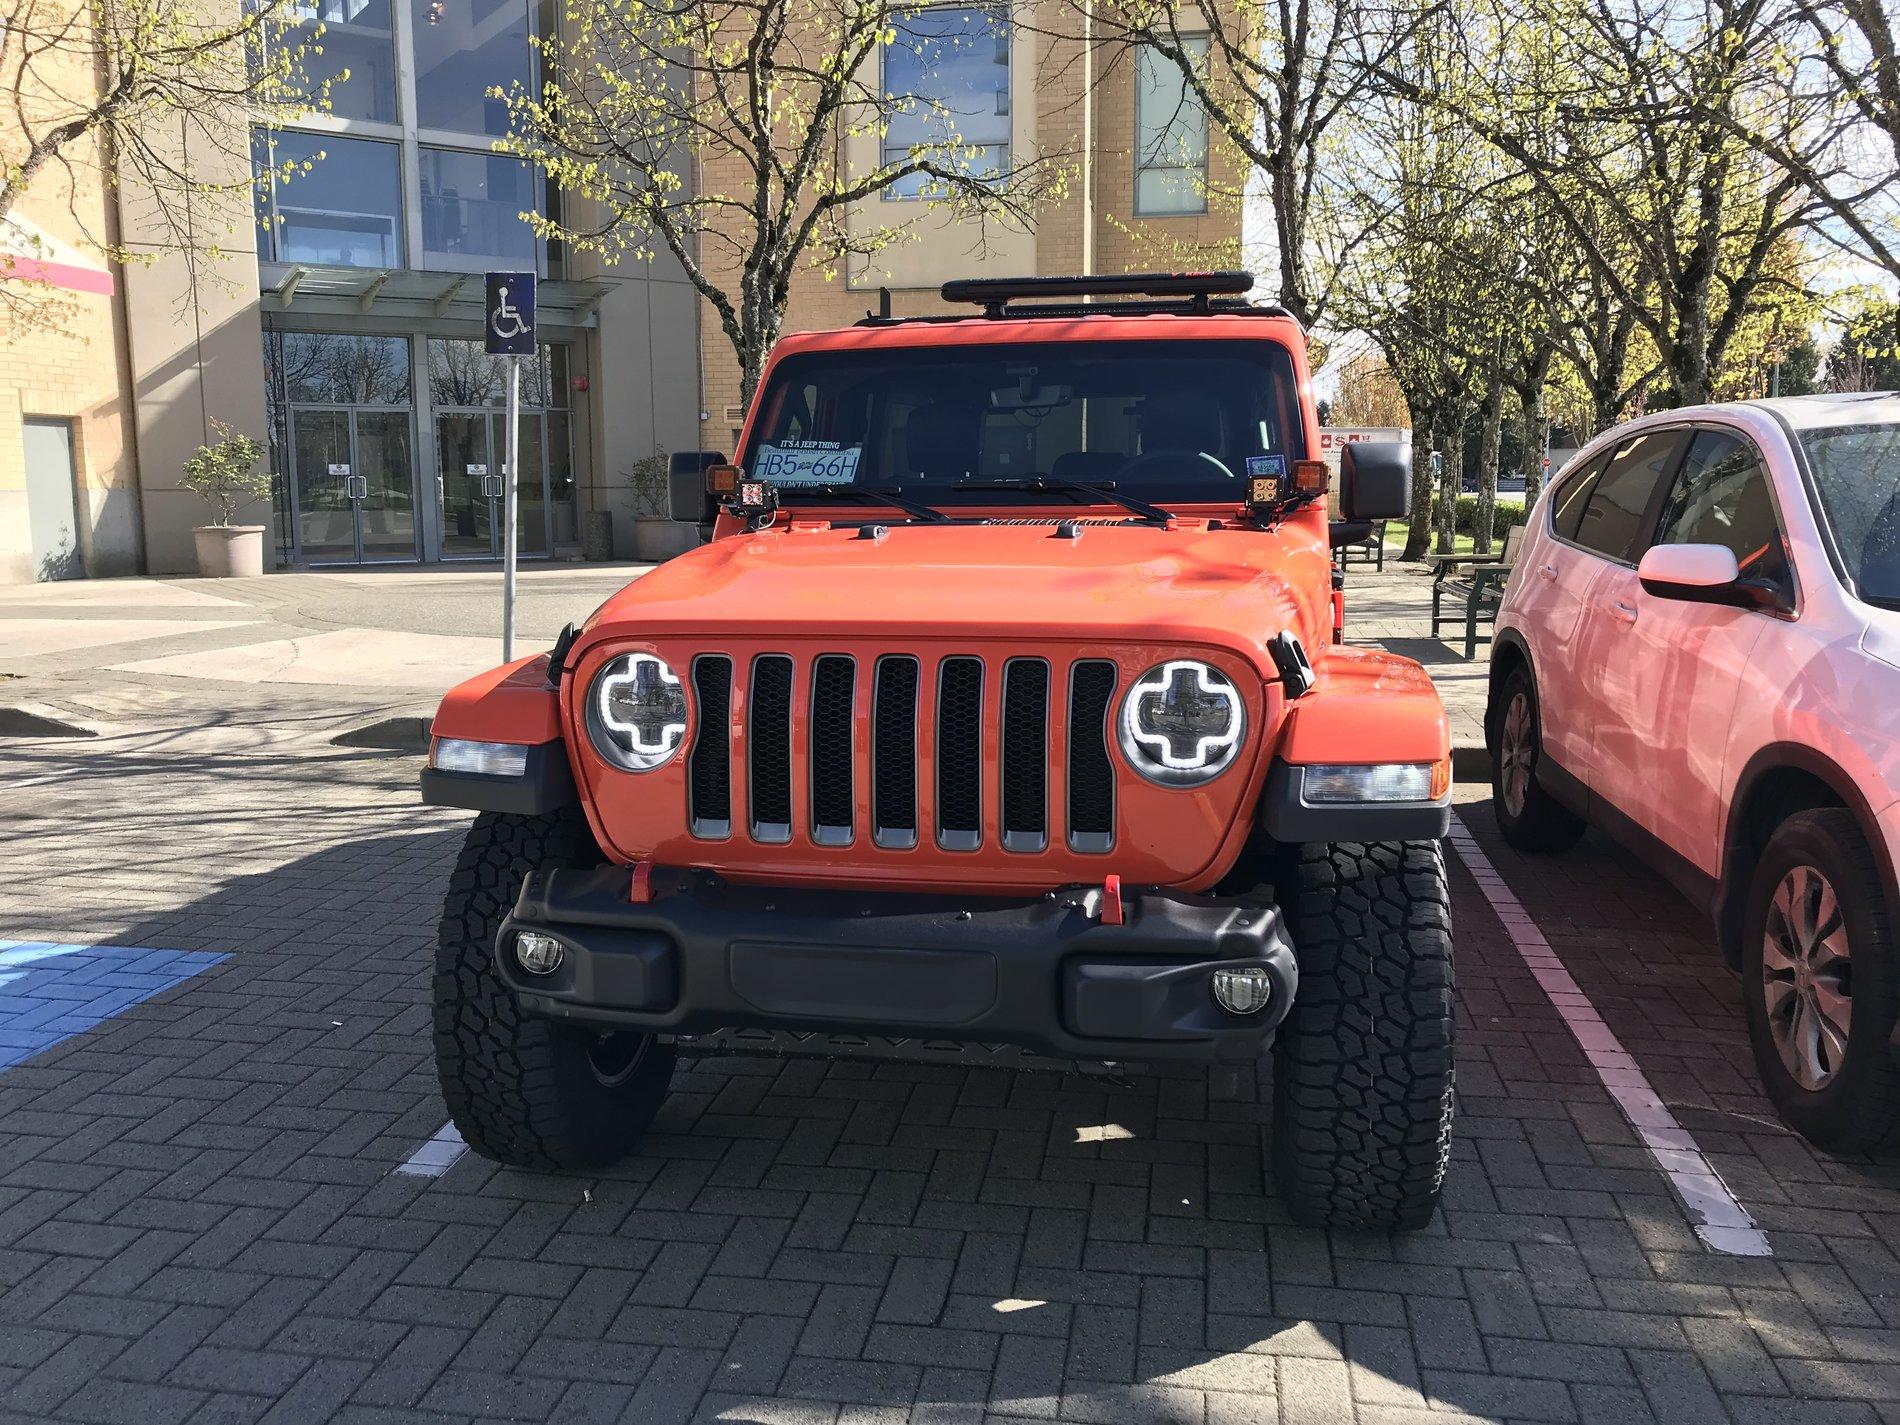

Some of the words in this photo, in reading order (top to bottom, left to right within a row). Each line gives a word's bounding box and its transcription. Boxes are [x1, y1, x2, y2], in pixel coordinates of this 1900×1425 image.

[780, 440, 794, 448] IT'S
[800, 441, 817, 449] JEEP
[818, 441, 840, 449] THING
[754, 454, 798, 475] HB5
[811, 455, 857, 477] 66H
